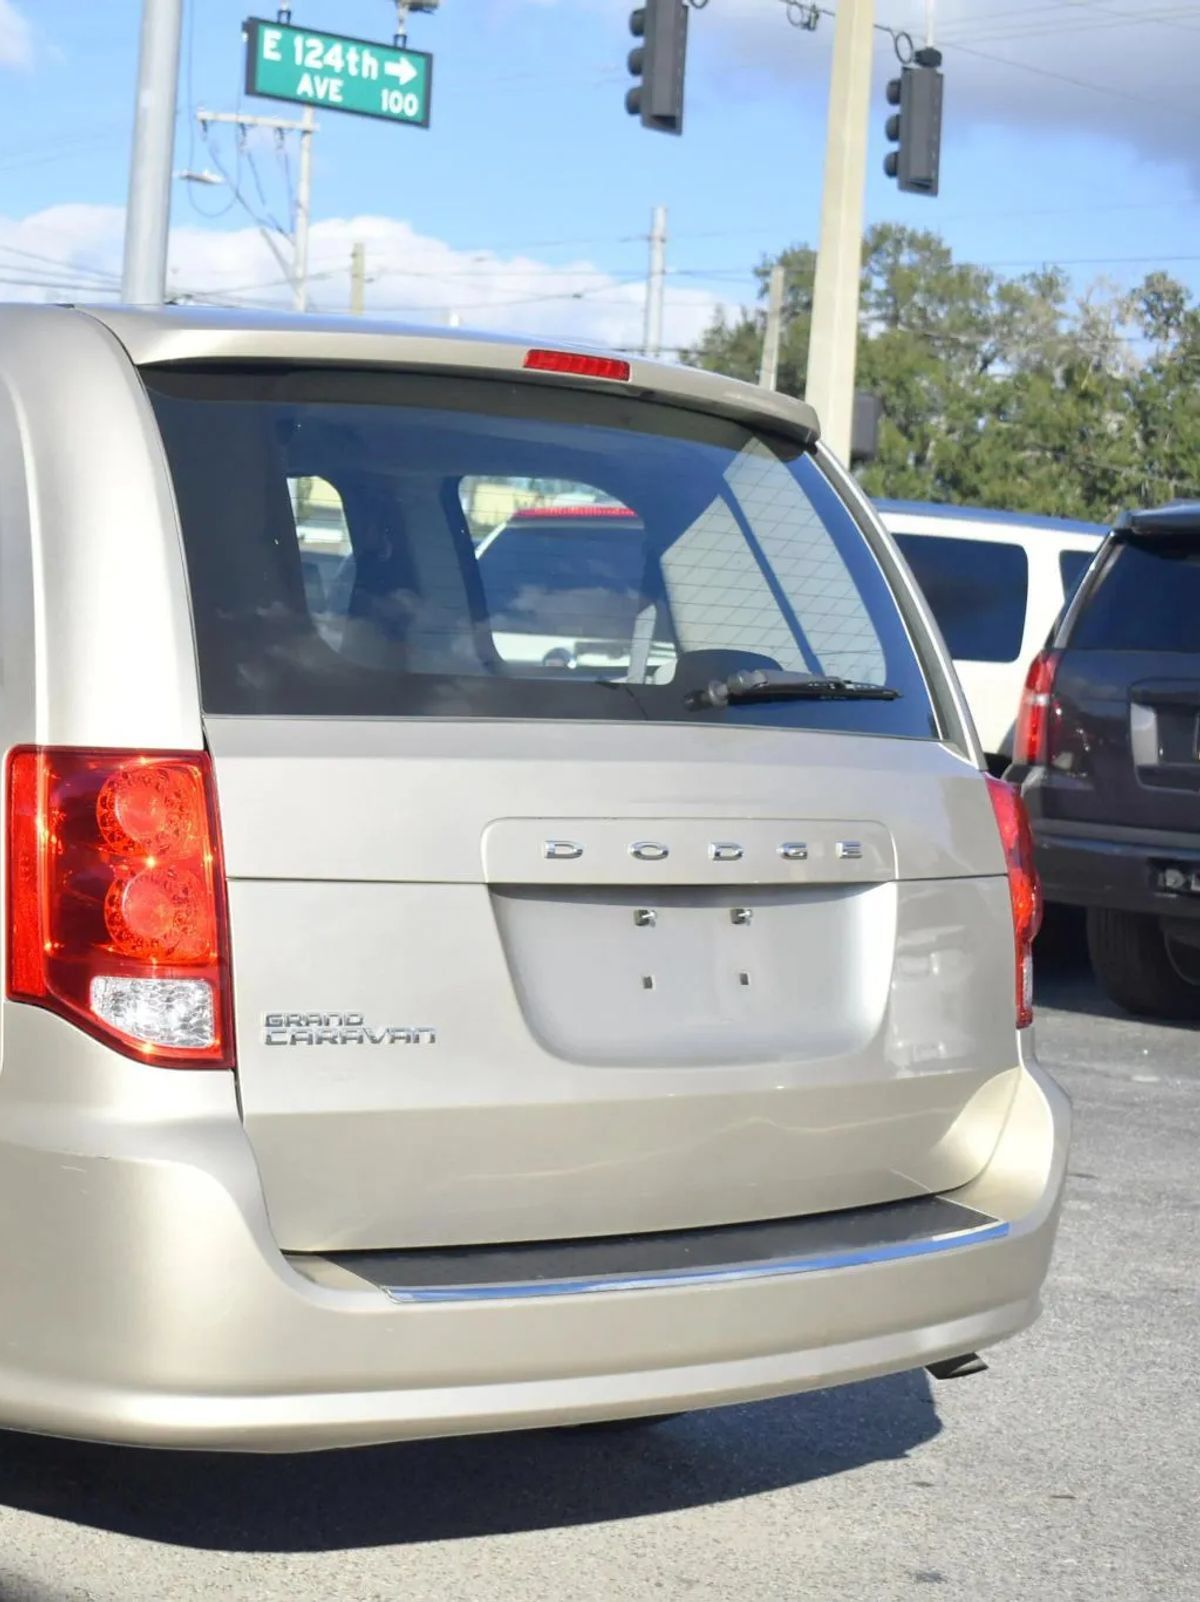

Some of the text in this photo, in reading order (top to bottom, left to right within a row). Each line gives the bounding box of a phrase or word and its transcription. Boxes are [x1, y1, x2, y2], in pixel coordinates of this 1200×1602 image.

[263, 29, 379, 80] E 124th
[297, 73, 344, 102] AVE
[381, 89, 419, 116] 100
[544, 839, 863, 861] DODGE
[264, 1012, 364, 1027] GRAND
[264, 1027, 437, 1046] CARAVAN
